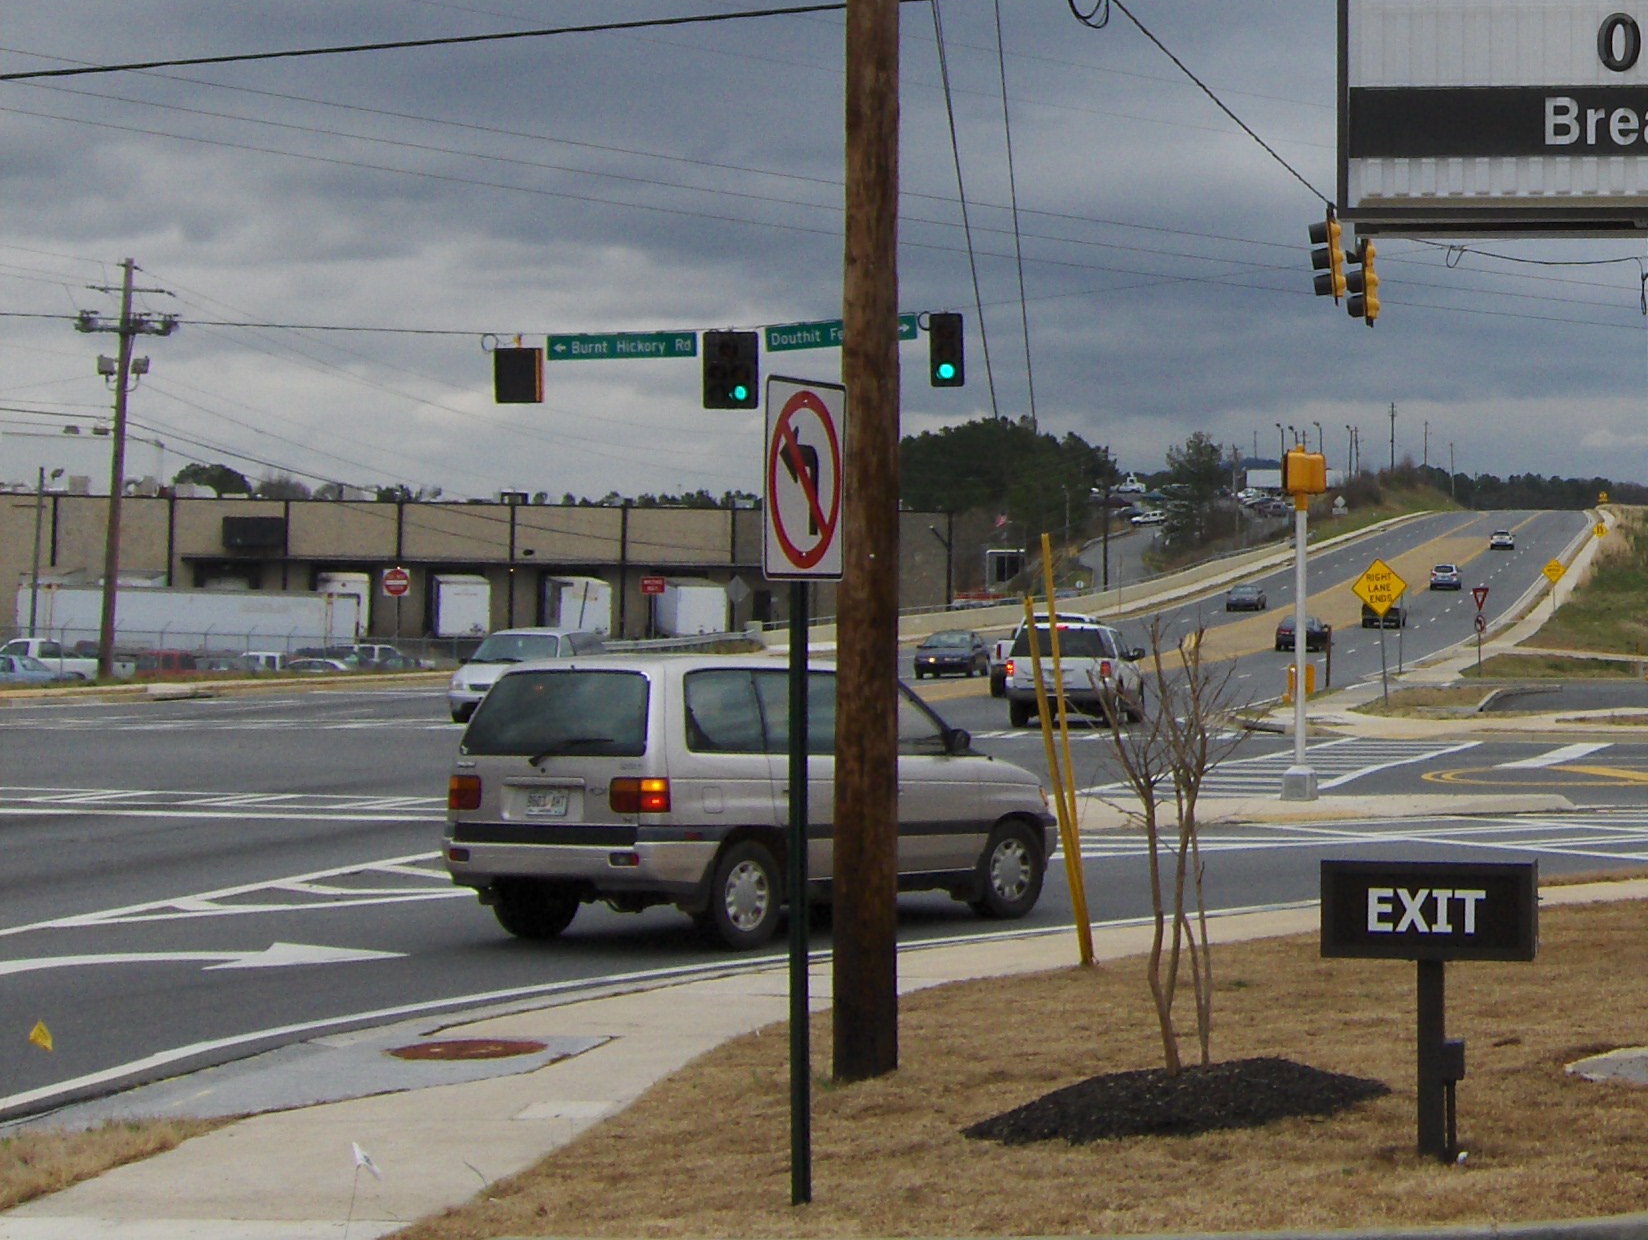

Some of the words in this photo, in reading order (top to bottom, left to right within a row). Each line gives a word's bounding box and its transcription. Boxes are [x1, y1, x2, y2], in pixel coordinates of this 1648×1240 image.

[771, 330, 821, 346] Douthit
[571, 341, 608, 354] Burnt
[616, 340, 666, 354] Hickory
[675, 338, 691, 351] Rd
[1366, 573, 1392, 581] RIGHT
[1367, 583, 1392, 593] LANE
[1370, 594, 1393, 603] ENDS
[1367, 887, 1487, 935] EXIT
